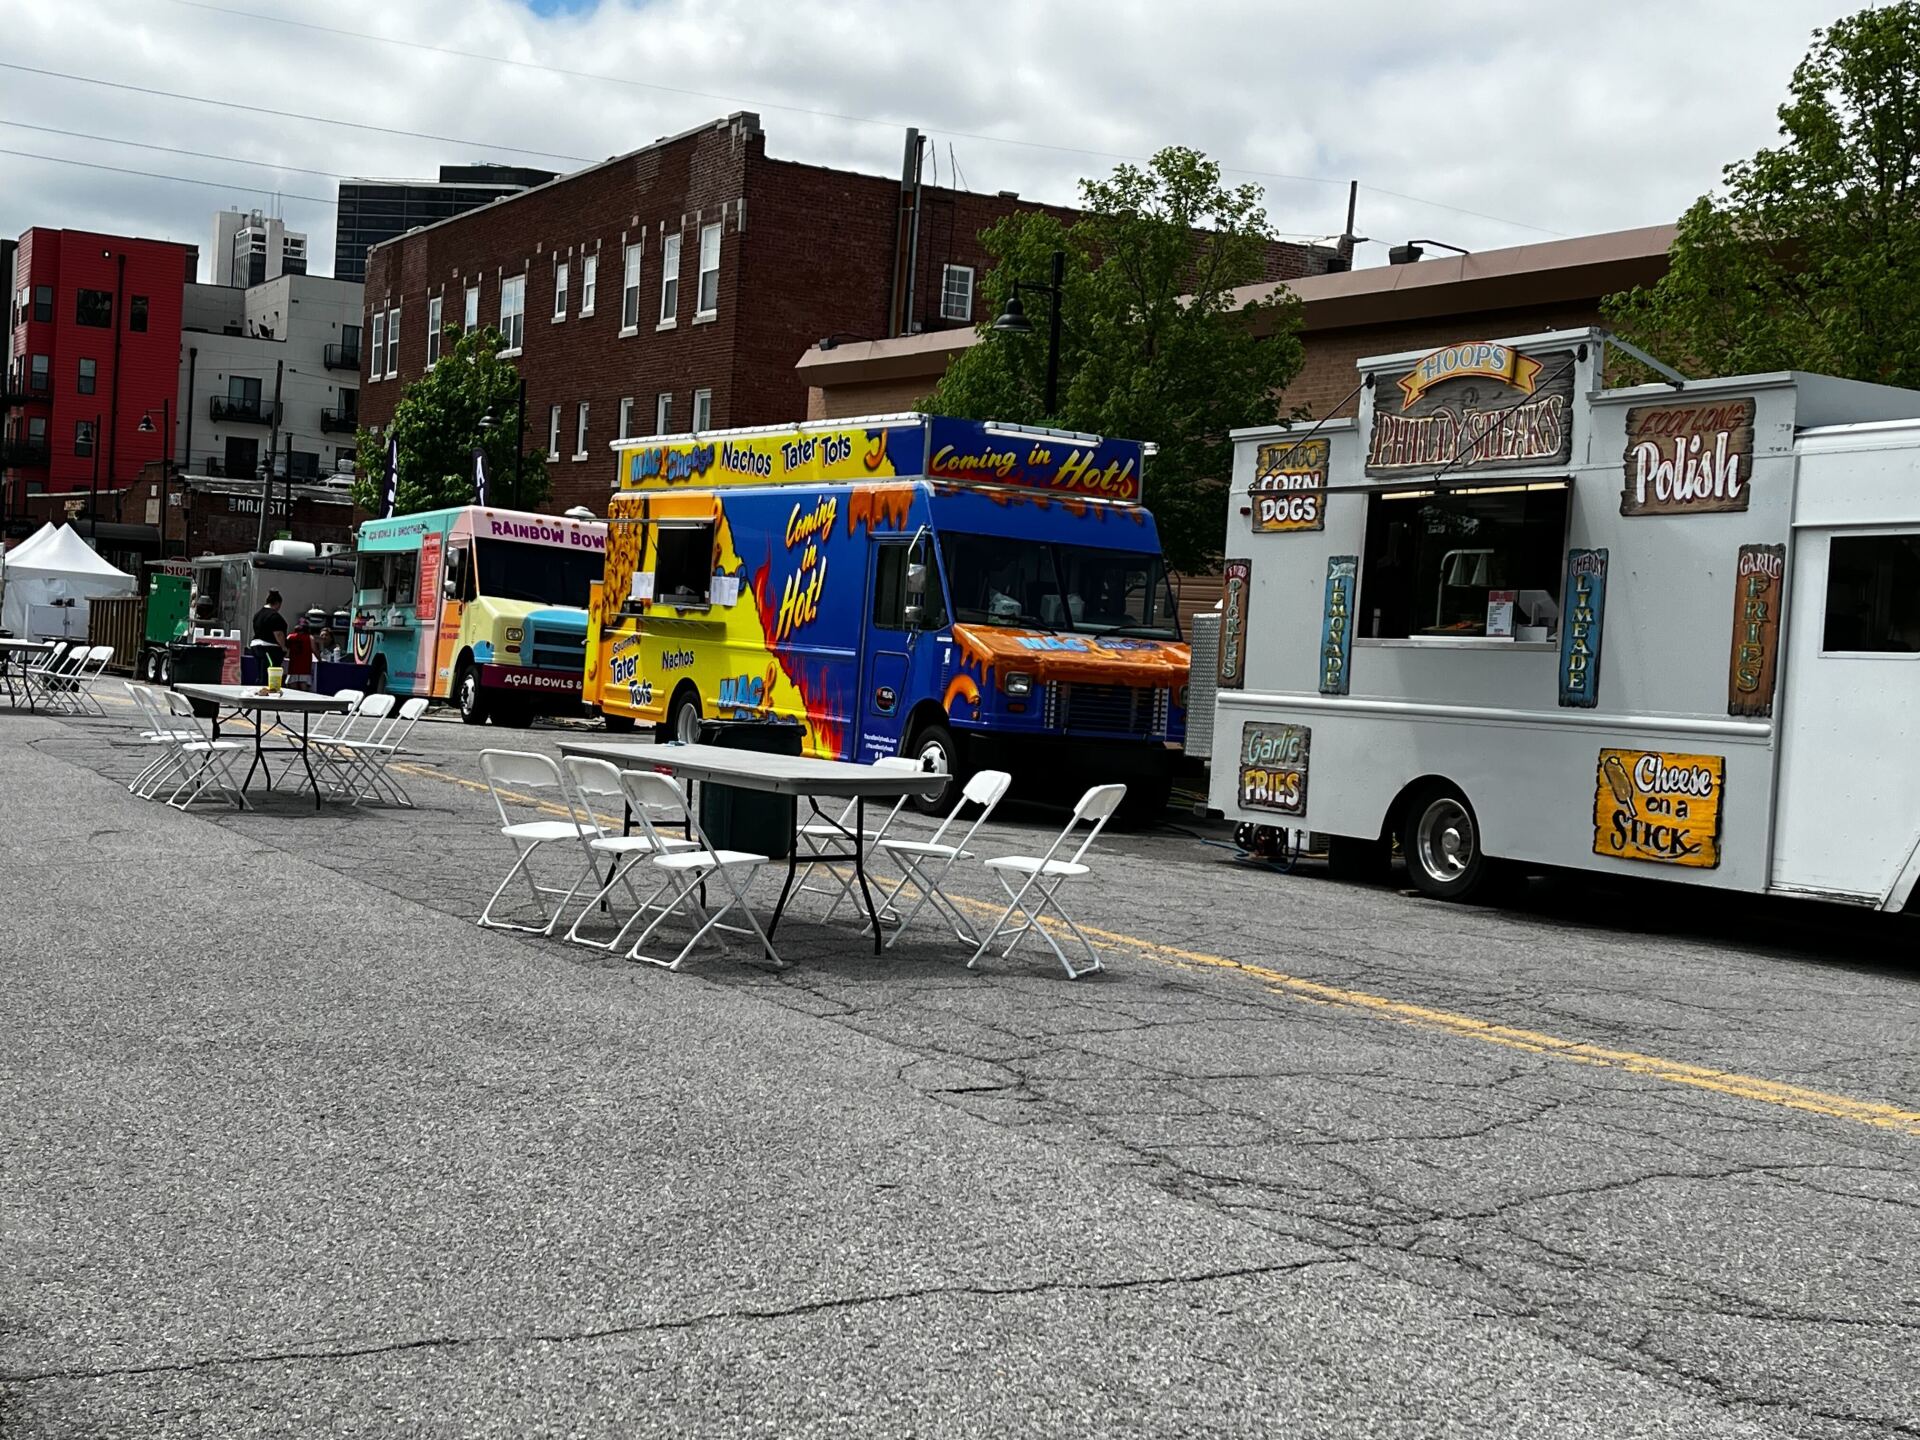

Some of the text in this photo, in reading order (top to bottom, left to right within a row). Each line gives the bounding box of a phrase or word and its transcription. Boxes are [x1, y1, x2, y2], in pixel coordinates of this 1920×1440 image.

[1423, 345, 1505, 380] HOOP'S
[1370, 394, 1564, 468] PHILLY STEAKS
[1638, 404, 1745, 436] FOOT LONG
[631, 448, 662, 483] MAC
[667, 443, 715, 484] Cheese
[721, 433, 852, 476] Nachos Tater Tots
[932, 443, 1134, 493] Coming in Hot!
[1266, 446, 1319, 470] JUMBO
[1631, 430, 1742, 504] Polish
[1260, 473, 1320, 491] CORN
[237, 499, 294, 516] MAJSTI
[785, 495, 838, 551] Coming
[1260, 498, 1317, 522] DOGS
[491, 520, 564, 543] RAINBOW
[166, 565, 191, 576] STOP
[802, 536, 817, 573] in
[1570, 553, 1606, 577] CHERRY
[1740, 552, 1782, 579] GARLIC
[776, 556, 827, 640] Hot!
[1222, 578, 1243, 678] PICKLES
[1326, 578, 1349, 687] LEMONADE
[1568, 576, 1594, 691] LIMEADE
[1736, 577, 1769, 693] FRIES
[610, 654, 639, 684] Tater
[662, 648, 694, 670] Nachos
[504, 674, 583, 689] AÇAÍ BOWLS &
[629, 678, 653, 708] Tots
[718, 674, 763, 709] MAC
[1248, 727, 1300, 765] Garlic
[1244, 769, 1301, 811] FRIES
[1633, 756, 1713, 798] Cheese
[1645, 796, 1688, 818] on a
